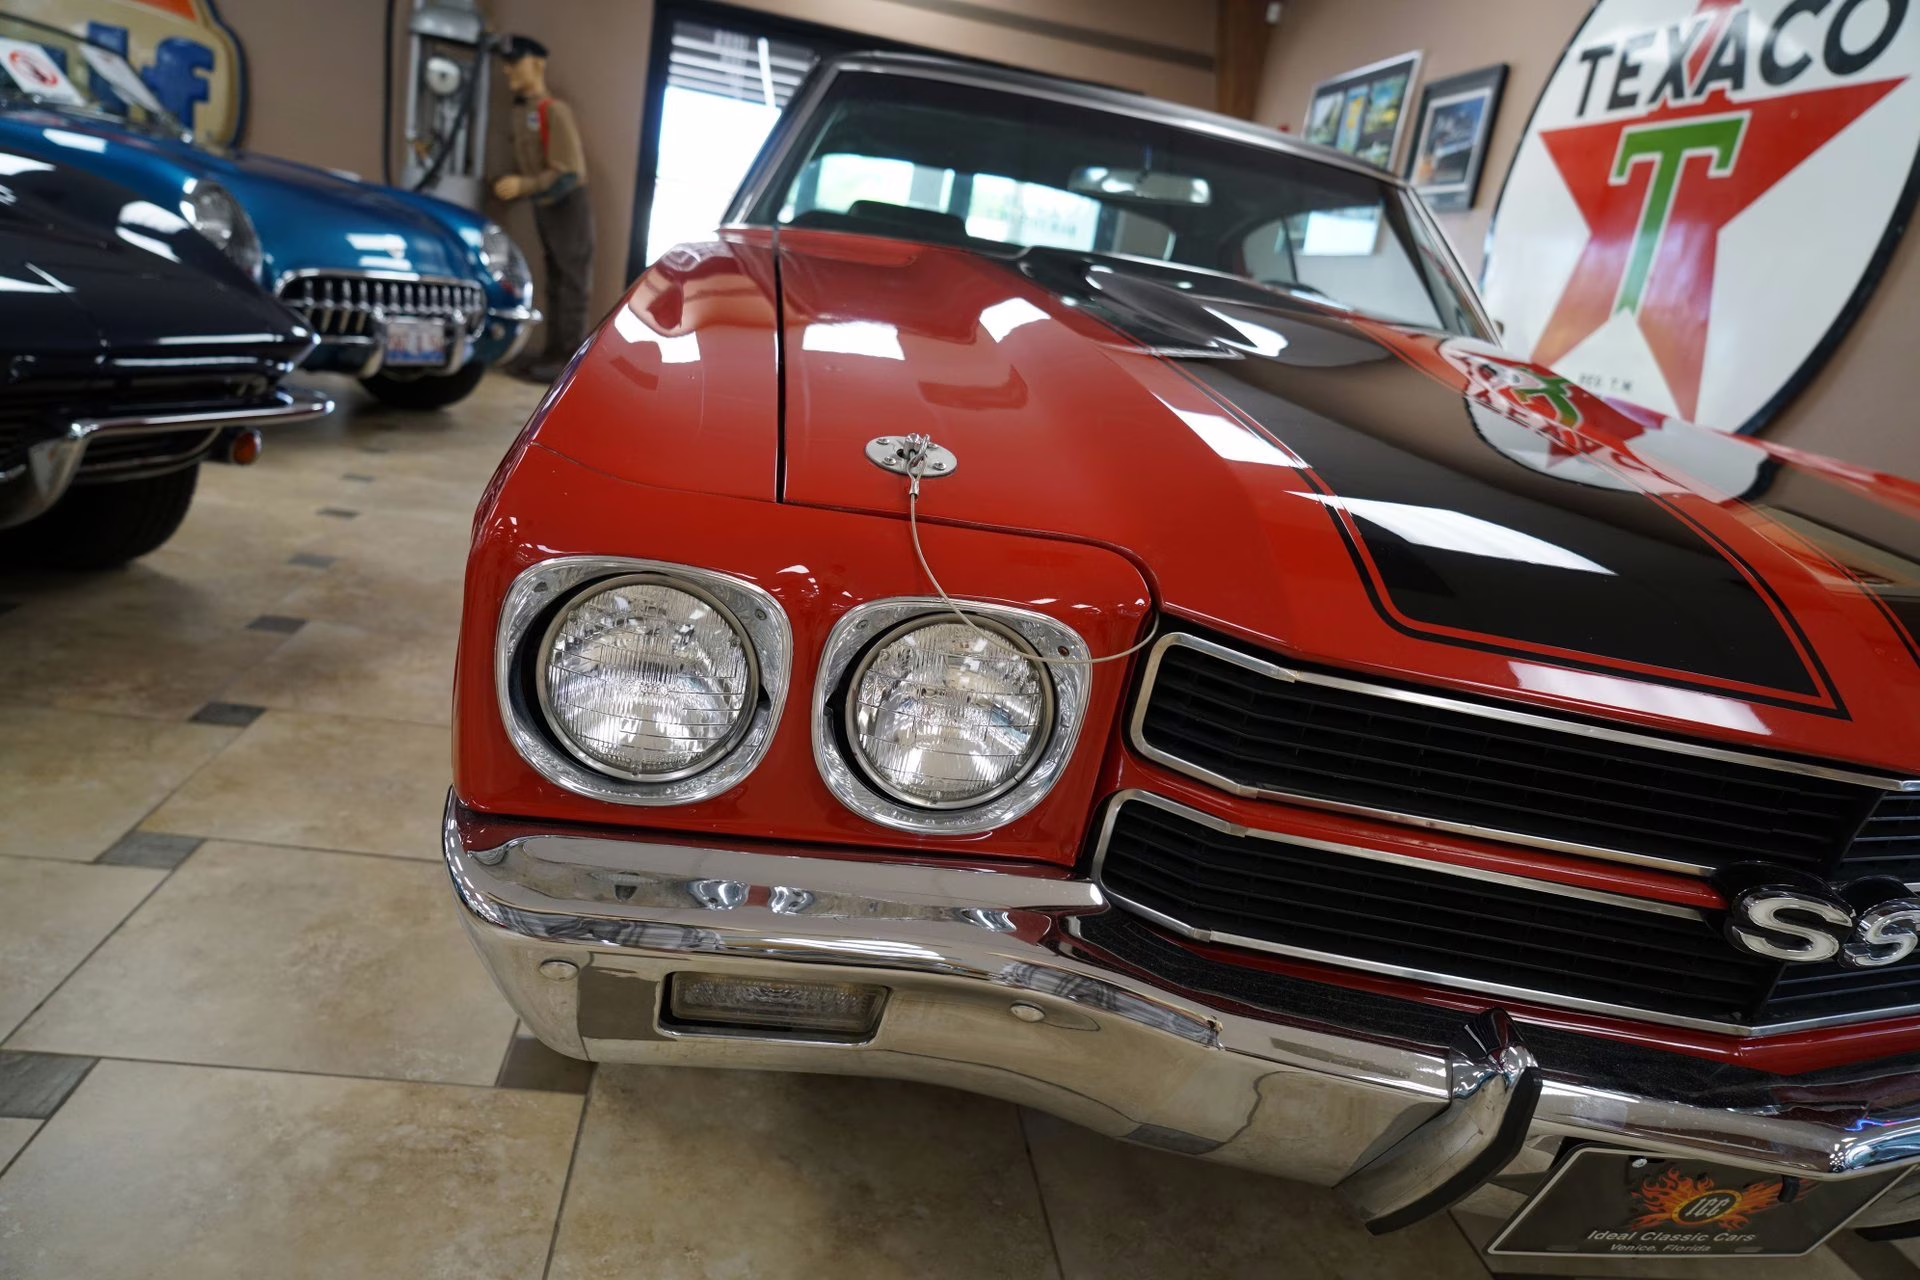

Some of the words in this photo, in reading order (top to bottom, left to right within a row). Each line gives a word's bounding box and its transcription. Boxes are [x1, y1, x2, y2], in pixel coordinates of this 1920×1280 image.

[1576, 0, 1909, 117] TEXACO
[1608, 109, 1752, 322] T
[1732, 890, 1920, 967] SS
[1587, 1230, 1637, 1241] Ideal
[1640, 1231, 1709, 1242] Classic
[1713, 1232, 1756, 1242] Cars
[1662, 1244, 1712, 1252] Florida
